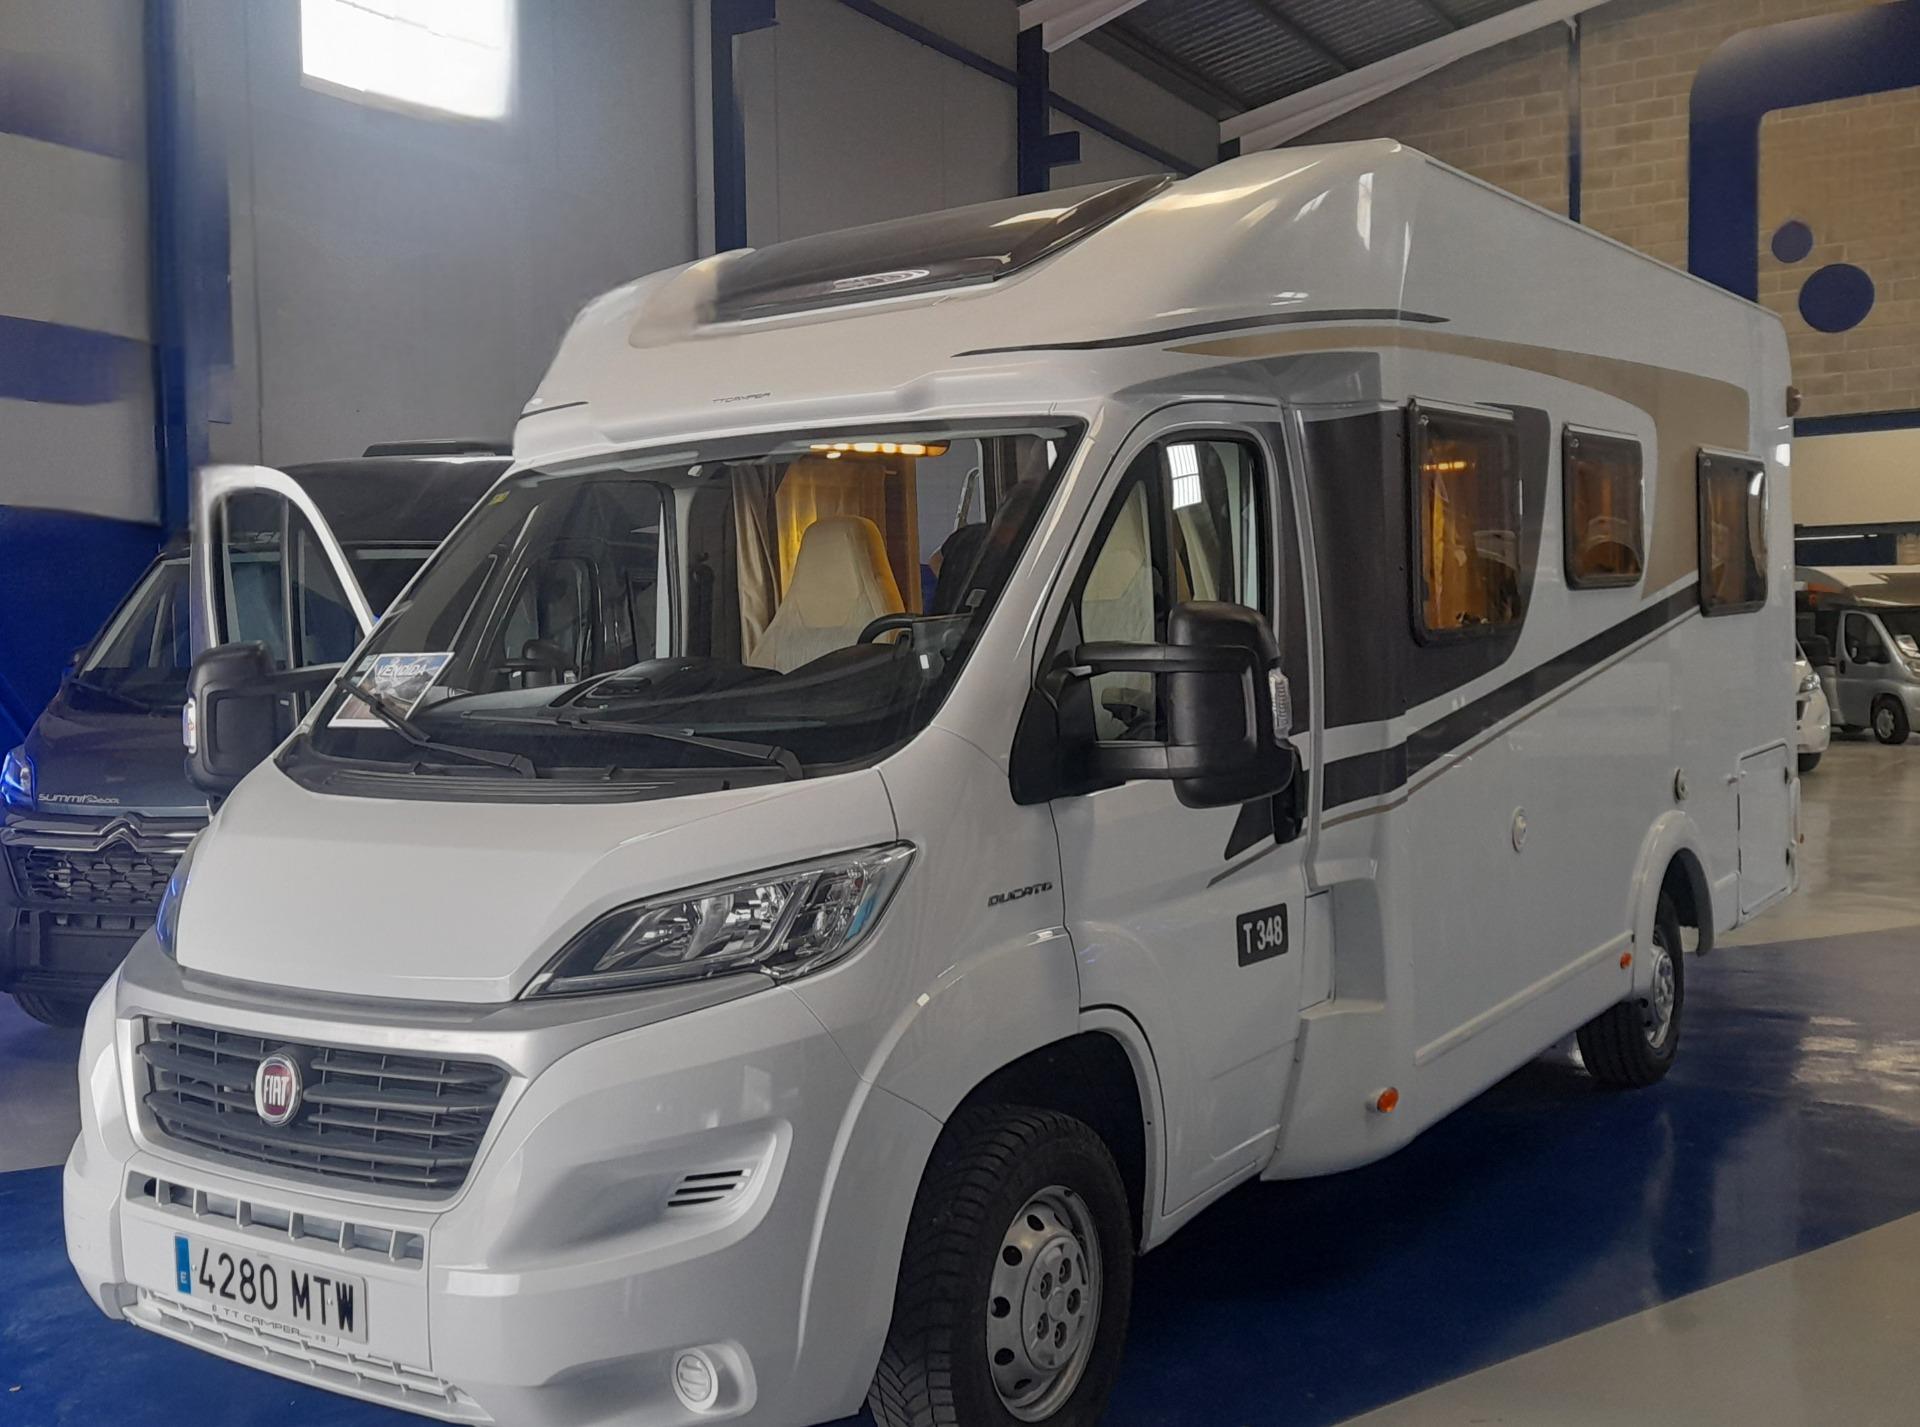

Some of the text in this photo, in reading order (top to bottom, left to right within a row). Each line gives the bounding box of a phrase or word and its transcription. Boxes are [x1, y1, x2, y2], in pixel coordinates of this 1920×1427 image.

[987, 881, 1053, 907] DUCATO
[1243, 915, 1283, 954] T 348
[264, 1074, 290, 1107] FIAT
[200, 1247, 354, 1333] 4280 MTW
